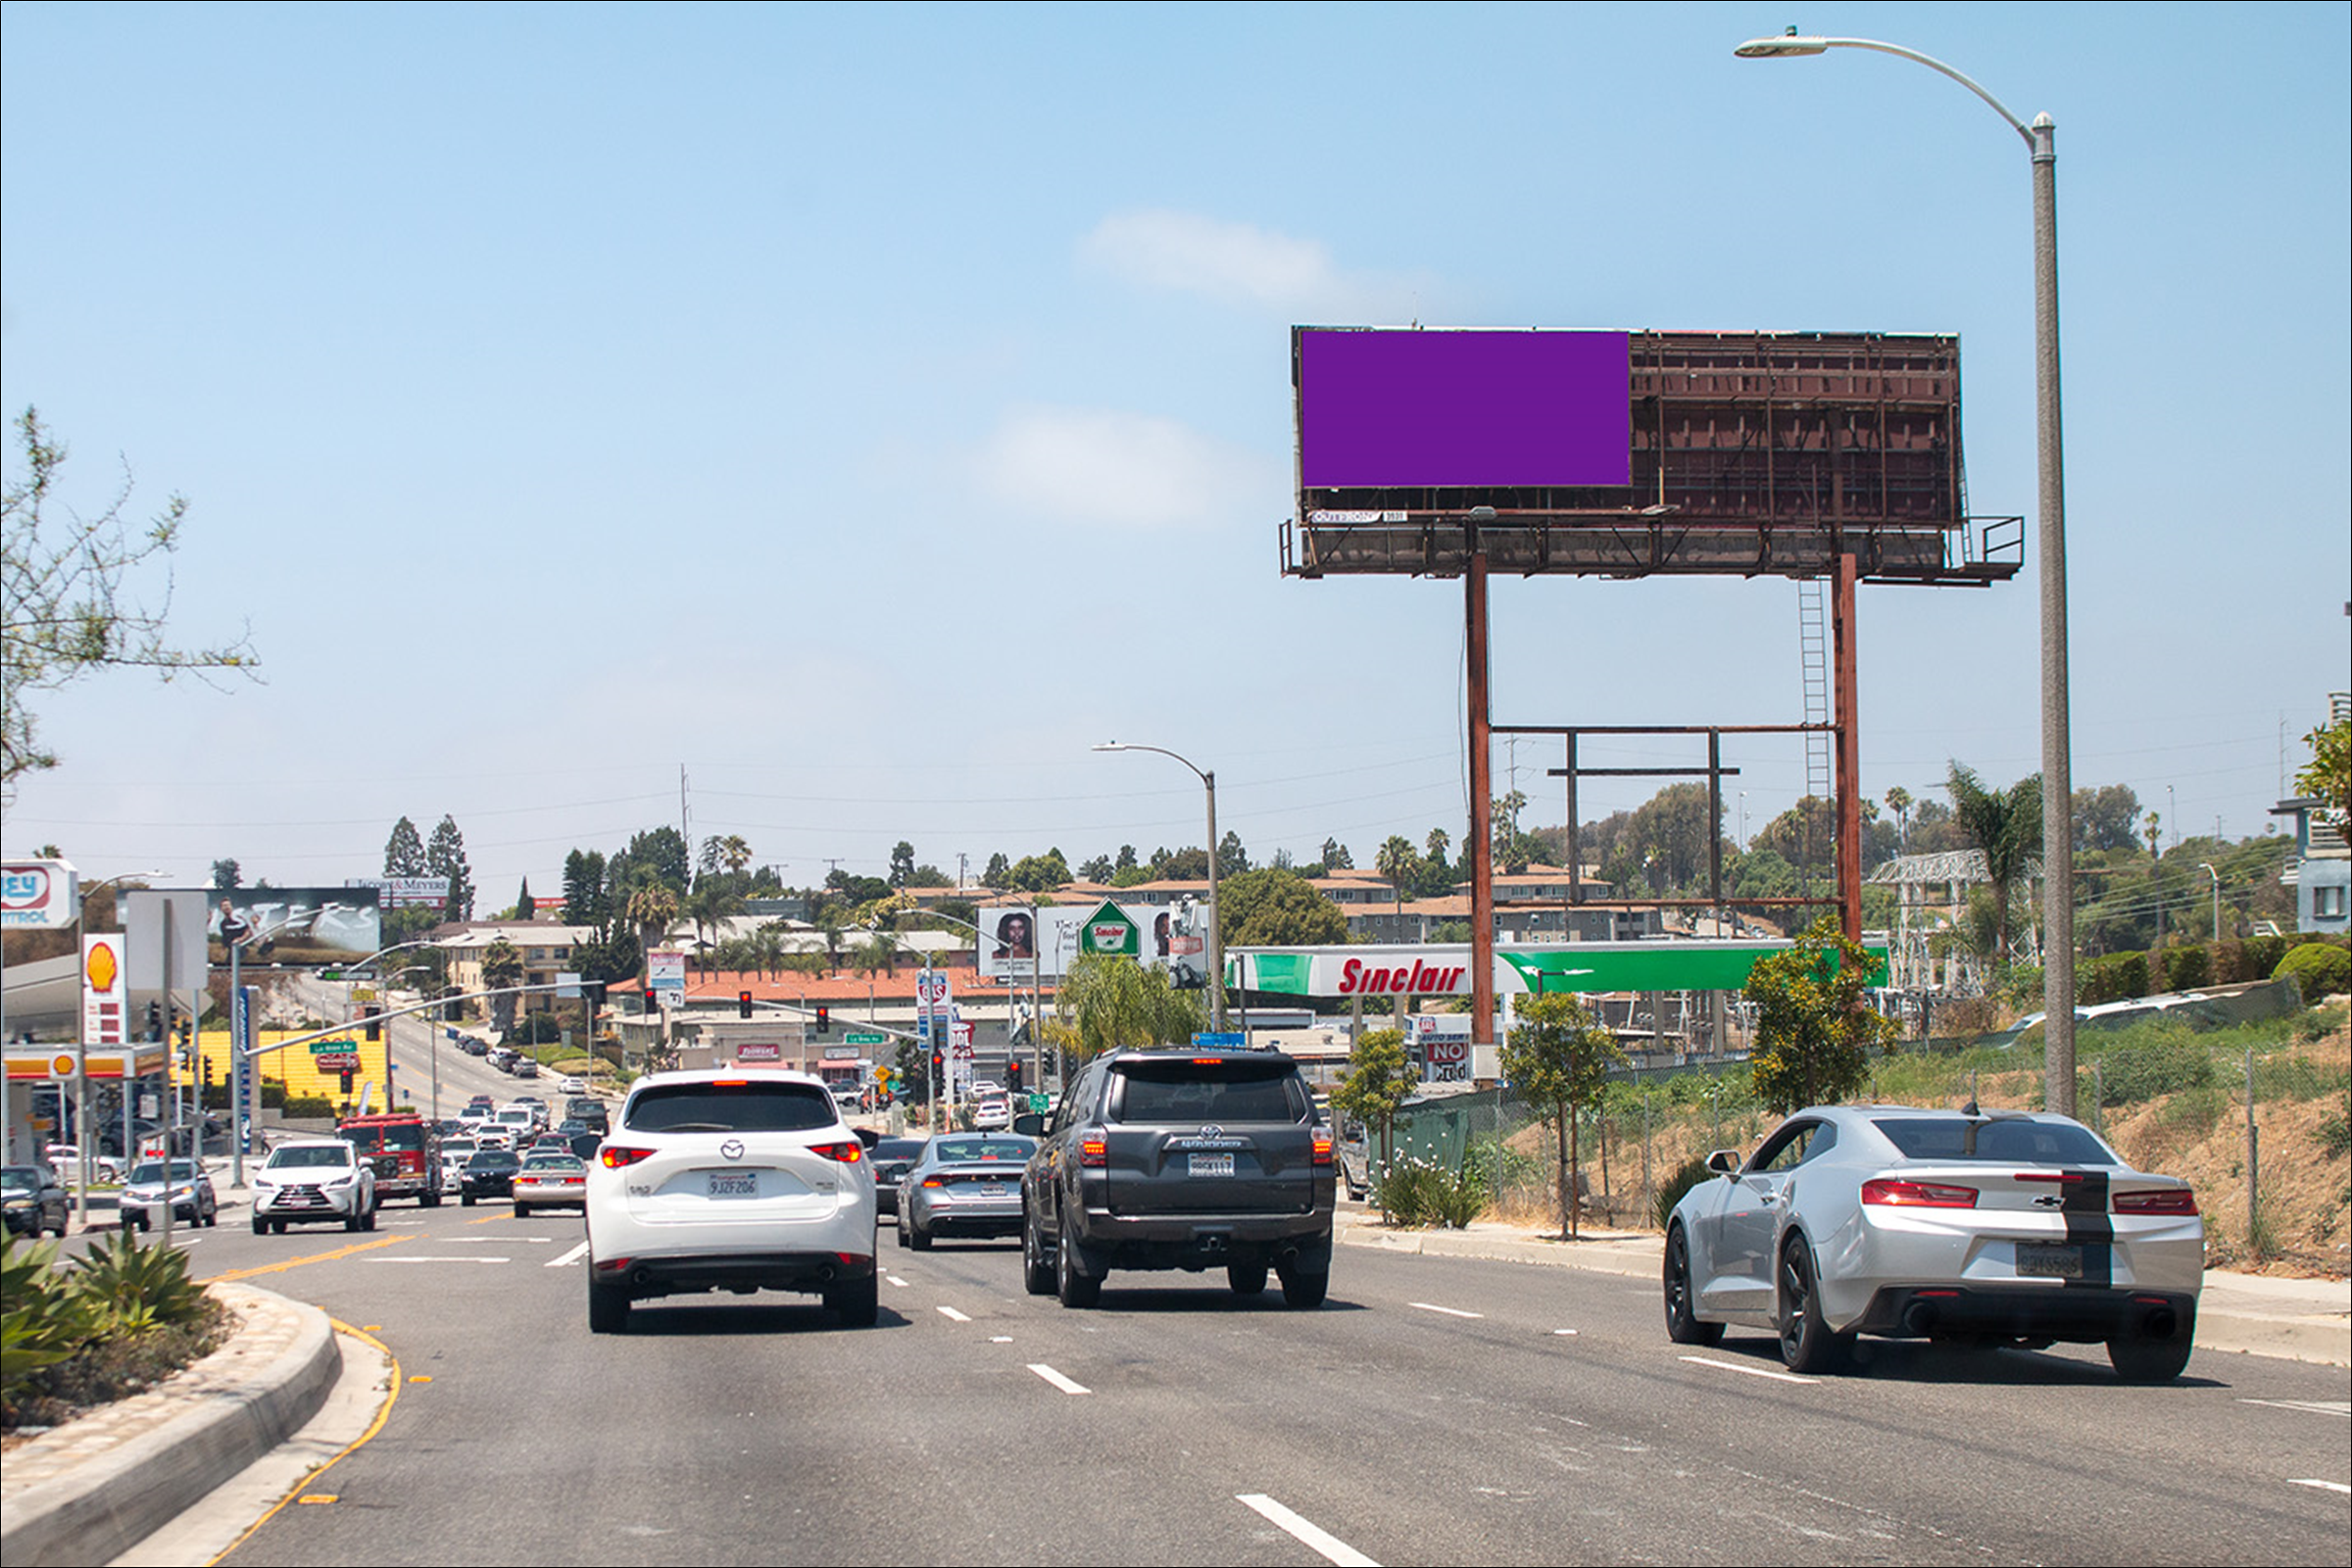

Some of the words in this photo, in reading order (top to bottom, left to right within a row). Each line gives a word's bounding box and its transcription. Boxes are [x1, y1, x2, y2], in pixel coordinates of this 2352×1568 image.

[1339, 958, 1465, 994] Sinclair
[1434, 1044, 1463, 1059] NO
[710, 1180, 756, 1195] 9JZF206
